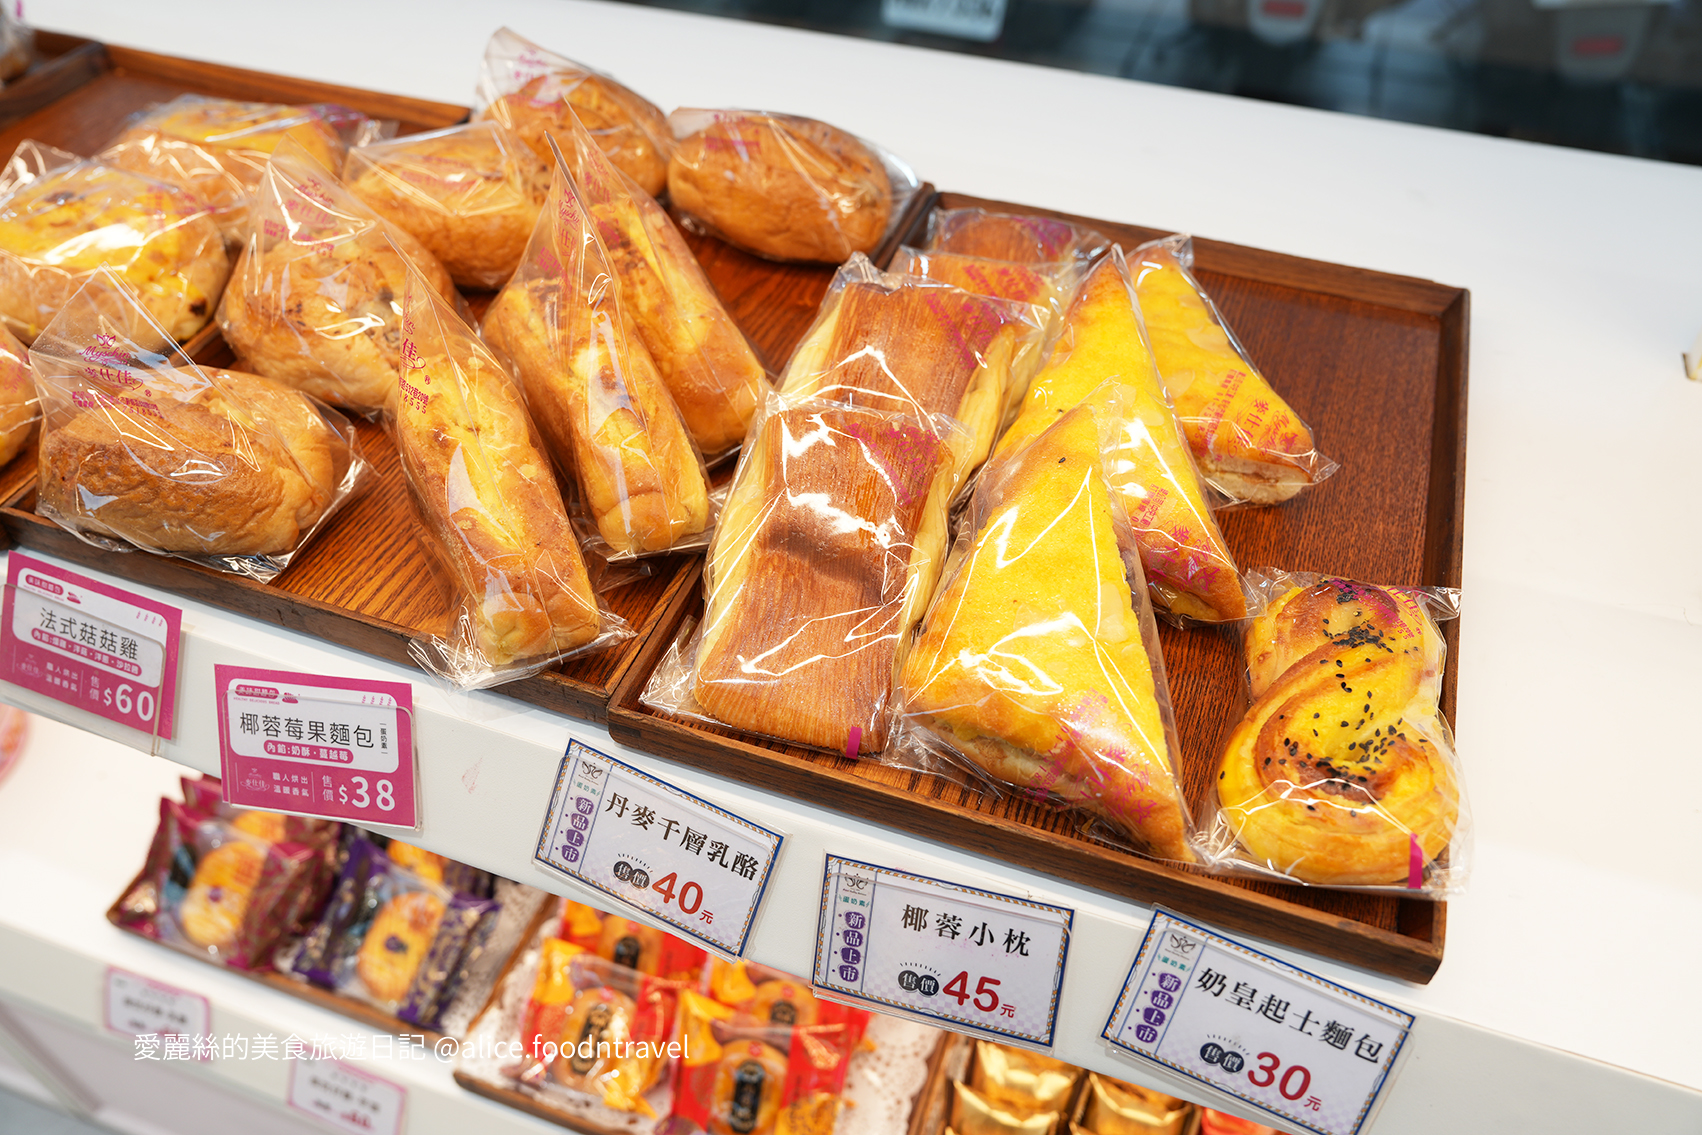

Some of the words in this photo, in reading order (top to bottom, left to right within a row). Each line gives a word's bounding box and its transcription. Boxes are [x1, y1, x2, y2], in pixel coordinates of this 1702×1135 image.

[39, 607, 139, 661] 法式菇菇雞
[89, 675, 101, 702] 售價
[103, 683, 155, 722] $60
[239, 711, 375, 749] 椰蓉莓果麵包
[272, 771, 309, 785] 職人烘出
[321, 774, 334, 802] 售價
[338, 775, 396, 812] $38
[604, 791, 760, 881] 丹麥千層乳酪
[842, 912, 863, 981] 新品上市
[901, 904, 1031, 957] 椰蓉小枕
[1138, 974, 1180, 1042] 新品上市
[1194, 967, 1384, 1065] 奶皇起士麵包
